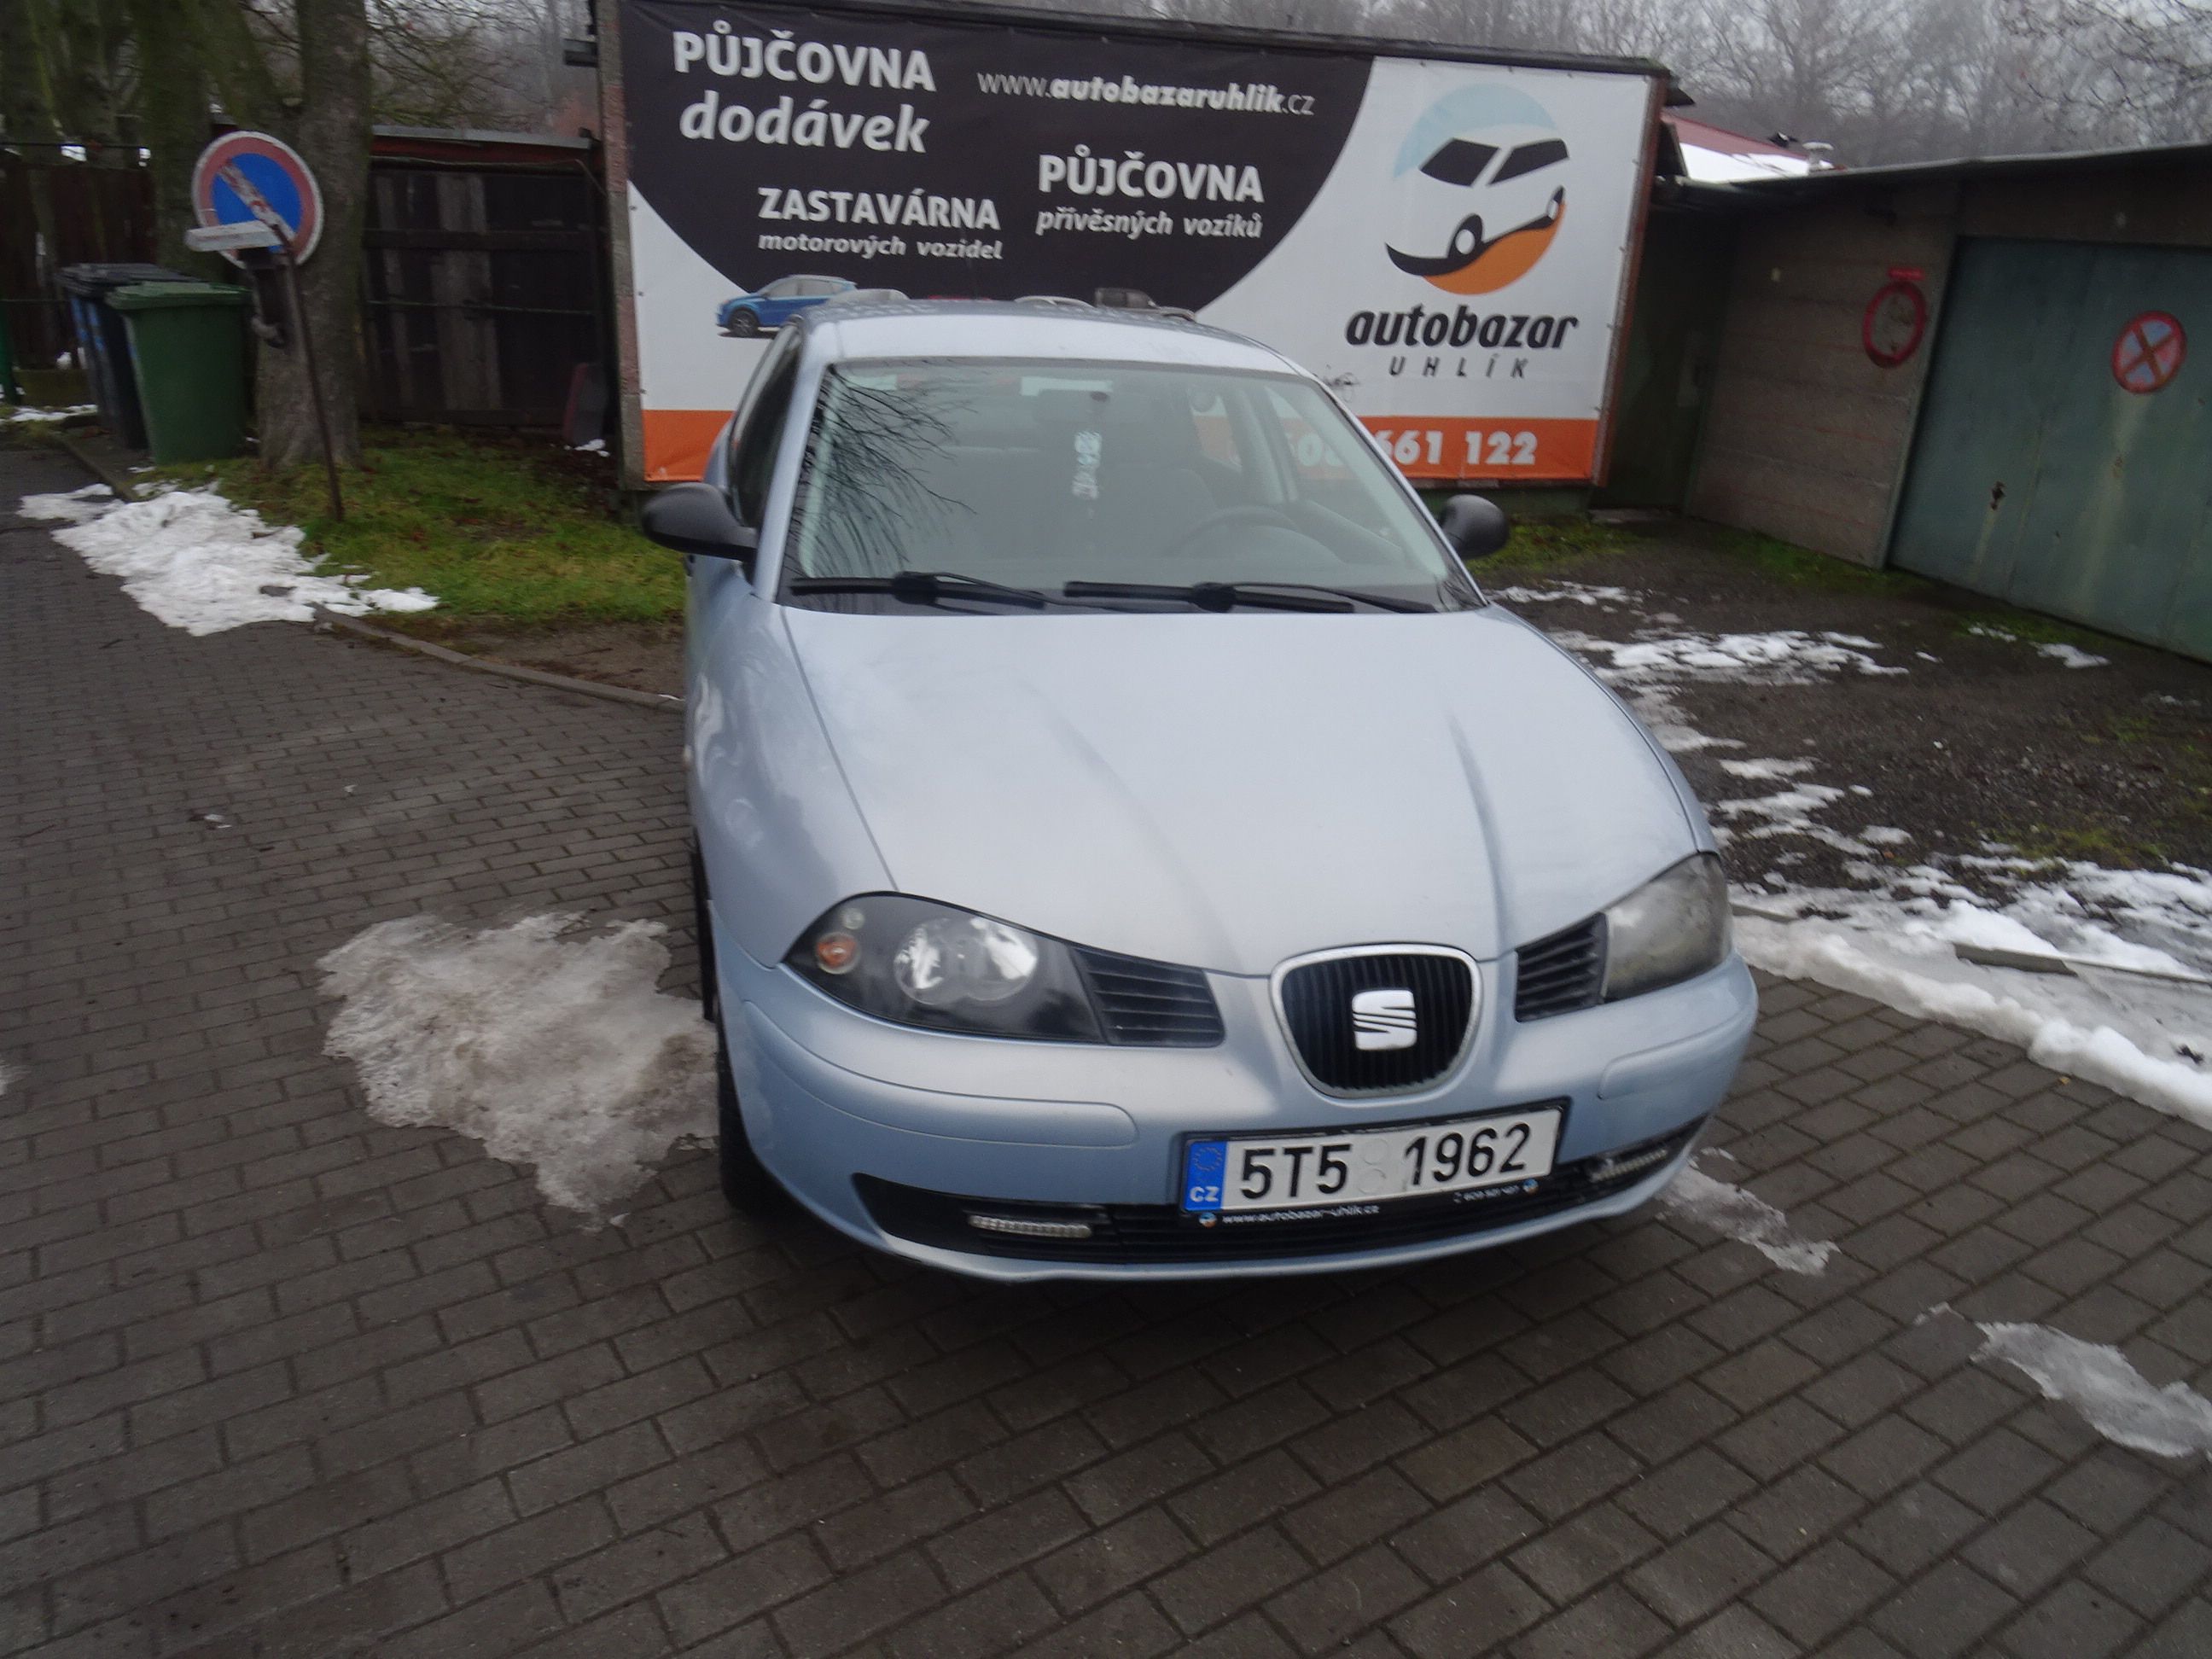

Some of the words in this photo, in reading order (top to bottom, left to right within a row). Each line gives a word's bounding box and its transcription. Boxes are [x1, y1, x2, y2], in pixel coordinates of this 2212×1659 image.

[672, 19, 937, 92] PŮJČOVNA
[679, 90, 930, 154] dodávek
[1038, 144, 1265, 202] PŮJČOVNA
[758, 187, 1001, 230] ZASTAVÁRNA
[758, 233, 907, 259] motorových
[917, 239, 1004, 259] vozidel
[1345, 303, 1579, 349] autobazar
[1389, 353, 1529, 379] UHLÍK
[1465, 430, 1538, 466] 122
[1240, 1144, 1353, 1200] 5T5
[1404, 1122, 1532, 1185] 1962
[1190, 1186, 1220, 1203] CZ
